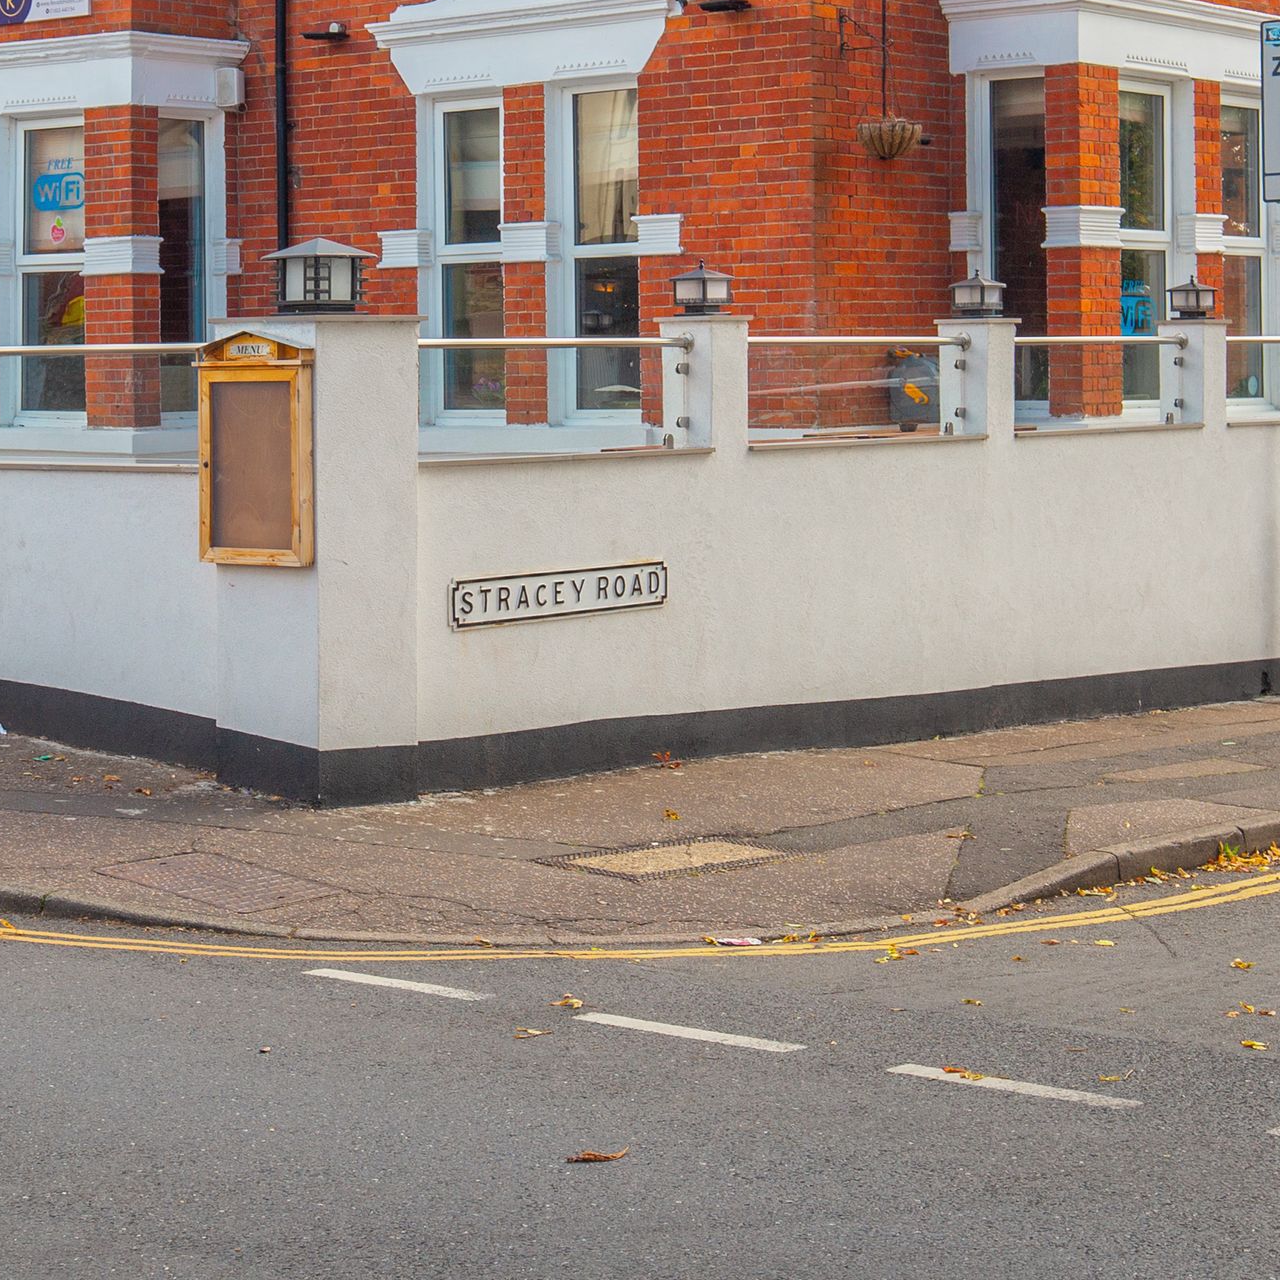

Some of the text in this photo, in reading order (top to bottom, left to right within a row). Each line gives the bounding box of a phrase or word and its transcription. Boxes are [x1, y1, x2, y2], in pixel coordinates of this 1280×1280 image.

[47, 157, 74, 170] FREE
[38, 179, 81, 203] WiFi
[236, 344, 264, 354] MENU
[460, 571, 660, 614] STRACEY ROAD
